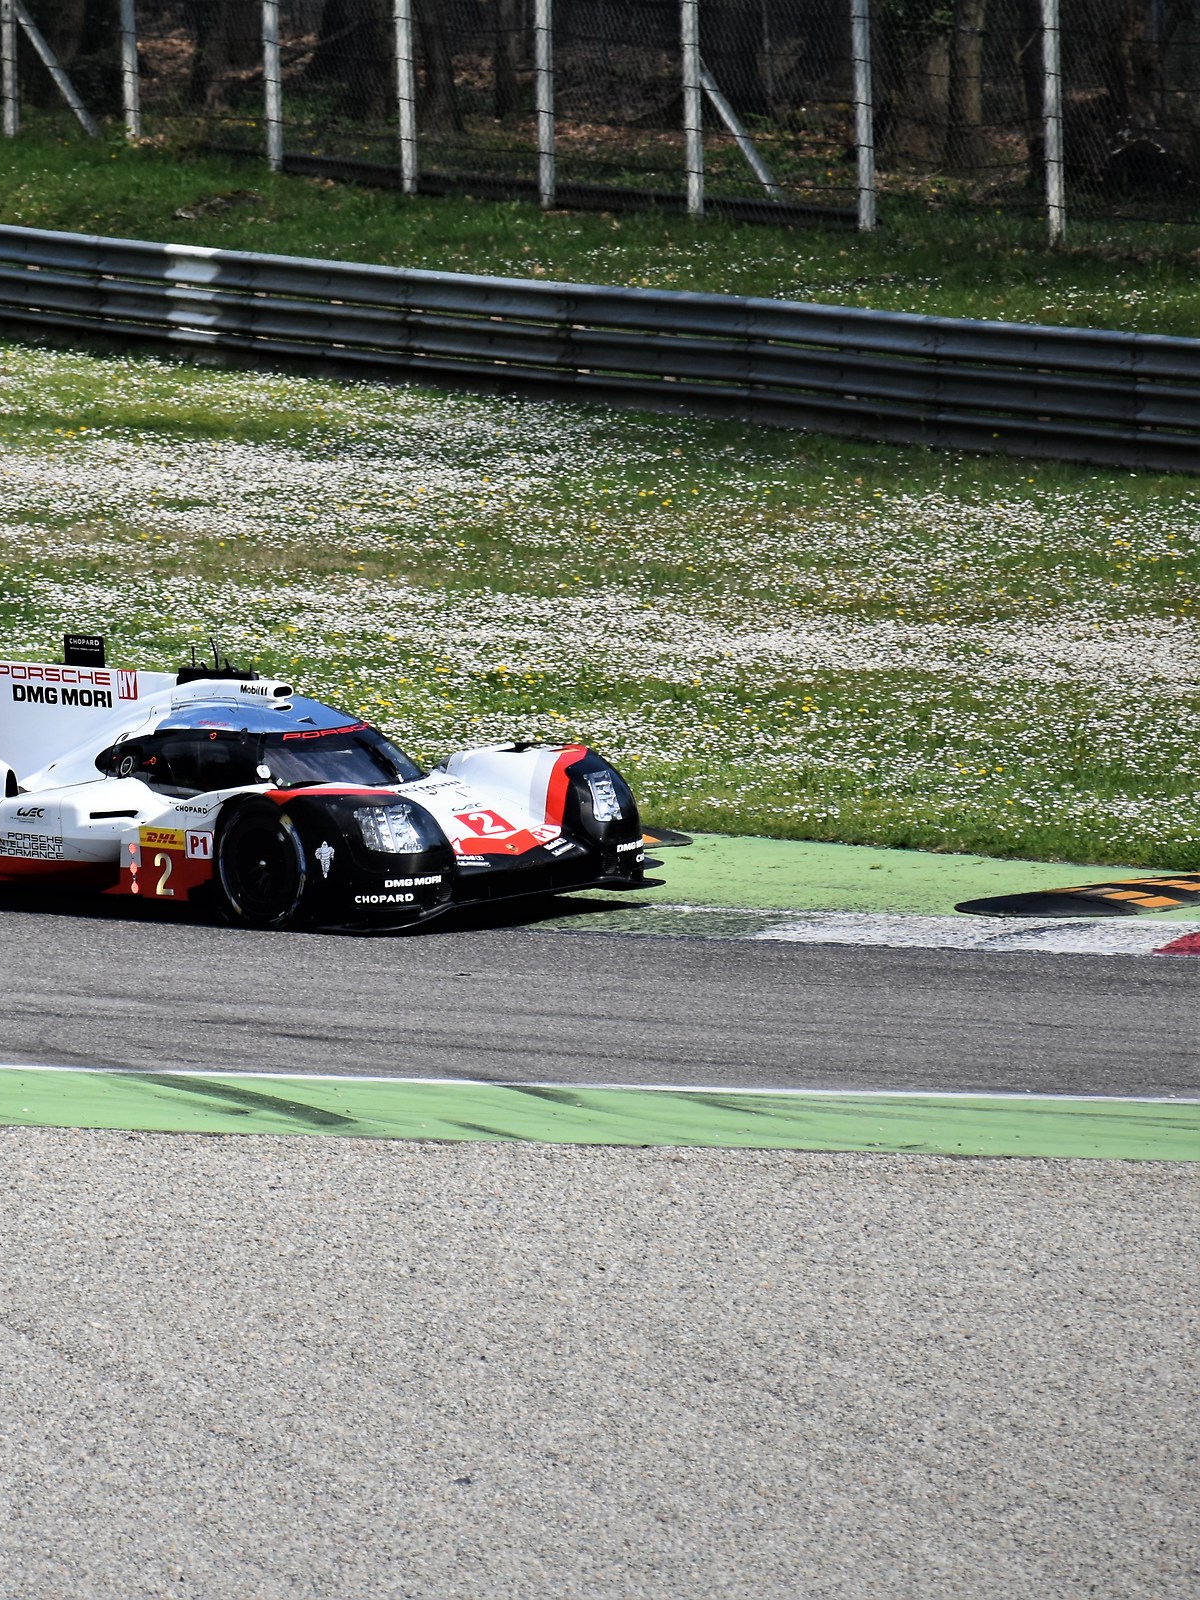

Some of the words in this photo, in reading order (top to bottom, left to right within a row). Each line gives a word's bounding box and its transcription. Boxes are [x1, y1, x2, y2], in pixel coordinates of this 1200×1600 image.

[68, 638, 100, 646] CHOPARD
[117, 670, 137, 699] HY
[12, 684, 58, 704] DMG
[62, 687, 113, 708] MORI
[16, 807, 45, 818] WEC
[175, 805, 208, 814] CHOPARD
[468, 812, 506, 834] 2
[7, 832, 63, 844] PORSCHE
[146, 832, 178, 845] DHL
[531, 827, 557, 839] P1
[190, 835, 209, 856] P1
[154, 852, 174, 896] 2
[384, 879, 413, 888] DMG
[414, 875, 442, 886] MORI
[354, 893, 414, 904] CHOPARD
